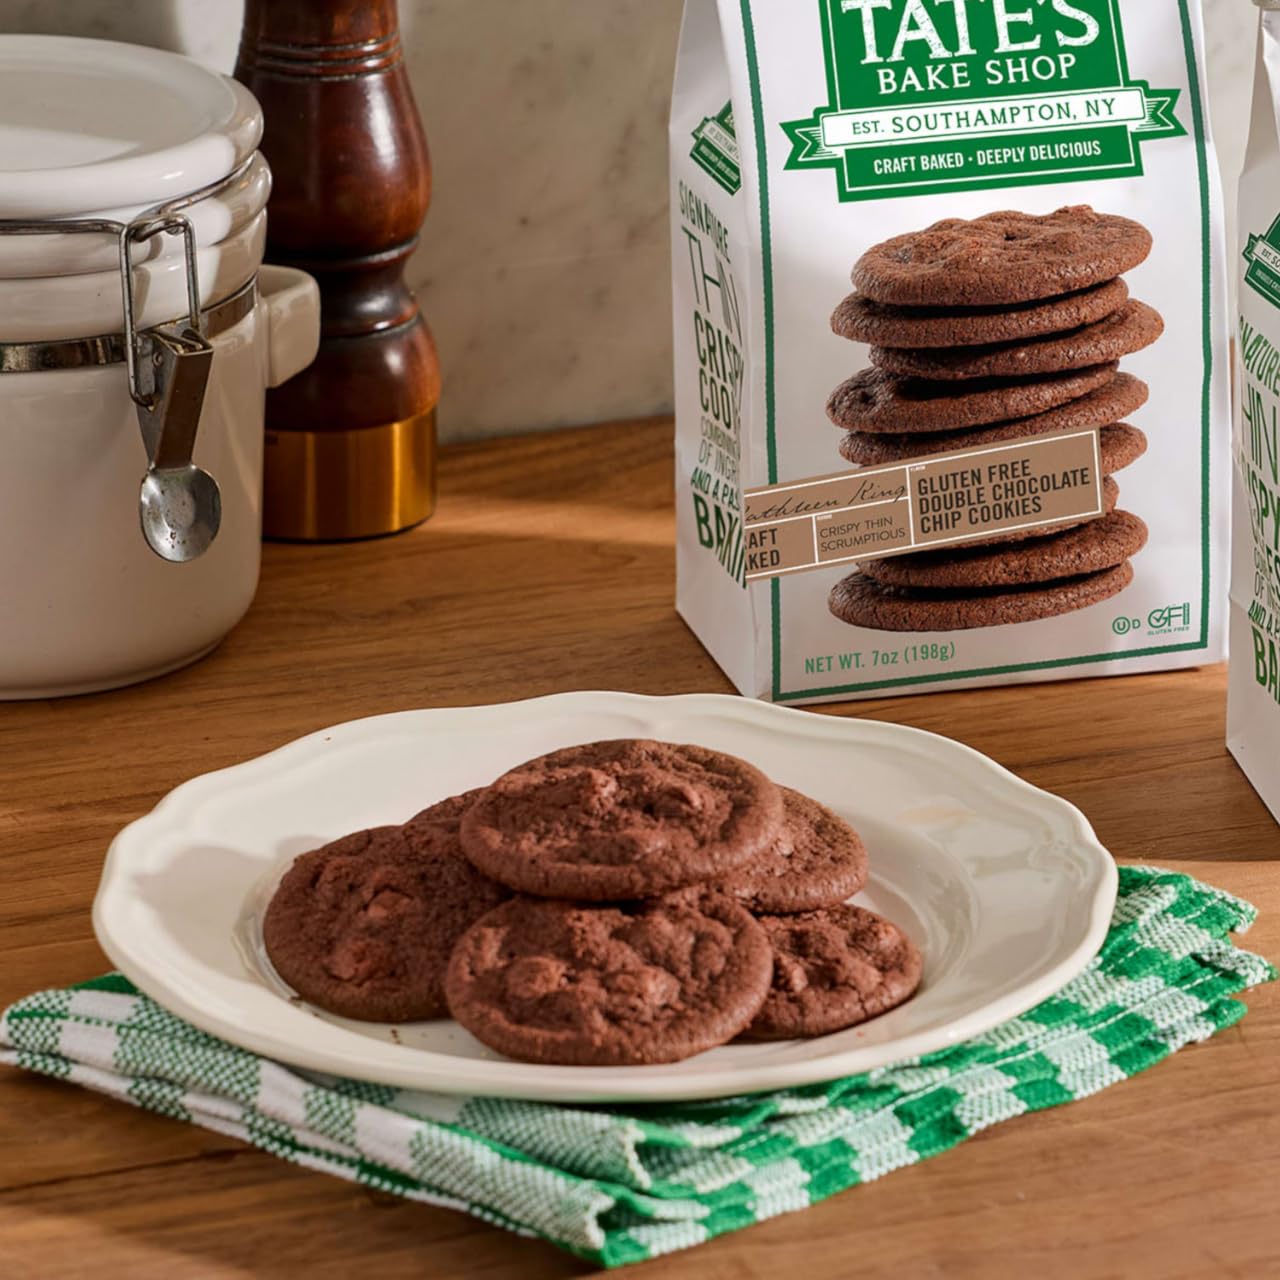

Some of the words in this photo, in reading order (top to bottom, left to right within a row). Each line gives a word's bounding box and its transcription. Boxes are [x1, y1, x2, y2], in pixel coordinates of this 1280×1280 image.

[877, 61, 972, 96] BAKE
[985, 53, 1077, 87] SHOP
[851, 118, 887, 136] EST.
[891, 102, 1079, 136] SOUTHAMPTON,
[1085, 96, 1117, 118] NY
[873, 155, 917, 176] CRAFT
[920, 151, 965, 172] BAKED
[976, 144, 1026, 167] DEEPLY
[1029, 139, 1103, 163] DELICIOUS
[679, 179, 731, 264] SIGNATURE
[681, 225, 743, 348] THIN
[1242, 383, 1278, 485] HIN
[690, 466, 711, 496] AND
[848, 479, 905, 504] King
[918, 468, 982, 496] GLUTEN
[988, 459, 1031, 483] FREE
[919, 486, 986, 515] DOUBLE
[992, 467, 1090, 501] CHOCOLATE
[819, 521, 860, 539] CRISPY
[864, 516, 893, 530] THIN
[921, 511, 961, 534] CHIP
[968, 496, 1042, 525] COOKIES
[745, 528, 778, 550] AFT
[820, 527, 906, 552] SCRUMPTIOUS
[805, 655, 834, 675] NET
[837, 651, 867, 672] WT.
[872, 648, 900, 667] 7oz
[903, 642, 956, 666] (198g)
